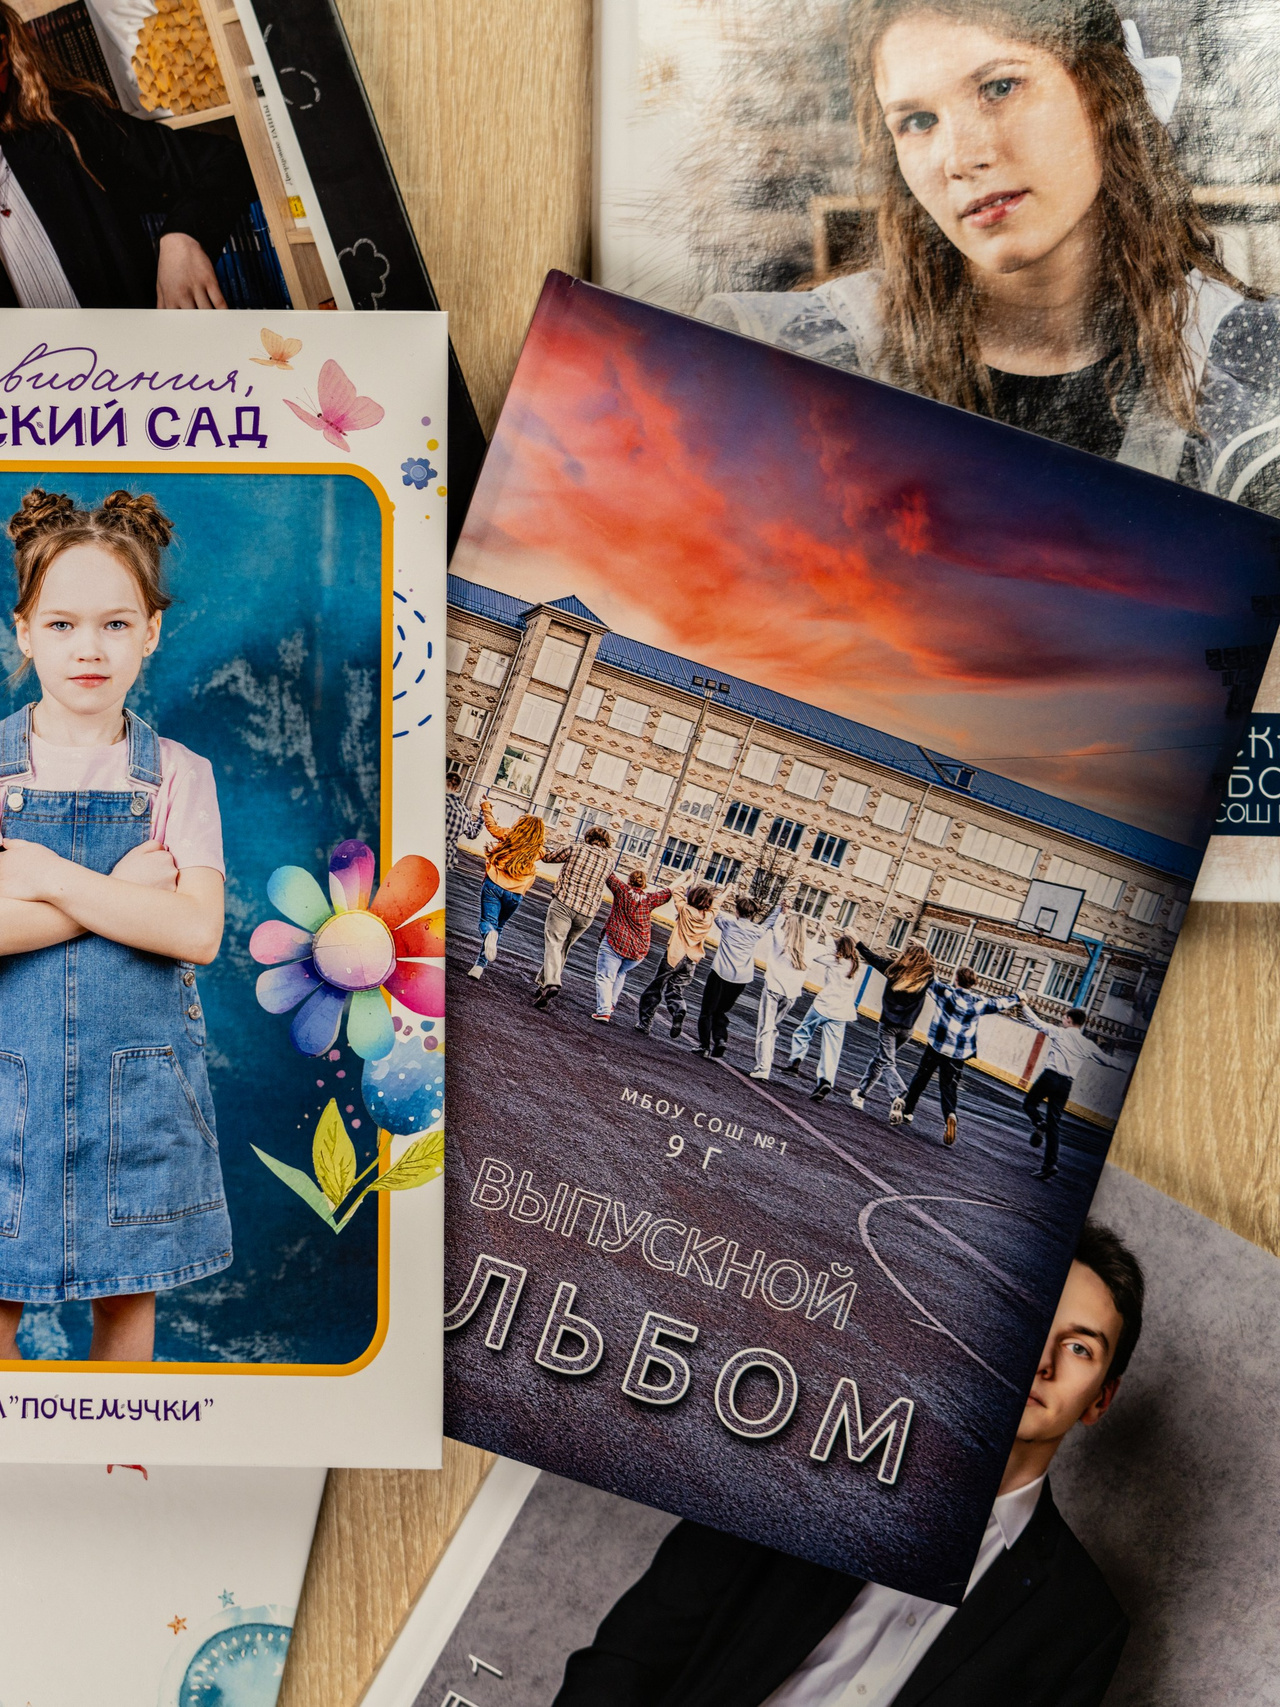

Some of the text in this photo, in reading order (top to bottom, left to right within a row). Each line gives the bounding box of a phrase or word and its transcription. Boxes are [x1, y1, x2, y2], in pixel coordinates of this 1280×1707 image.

[145, 405, 268, 450] САД
[621, 1087, 685, 1119] МБОУ
[693, 1112, 744, 1141] СОШ
[666, 1134, 723, 1170] 9 Г
[469, 1157, 858, 1331] ВЫПУСКНОЙ
